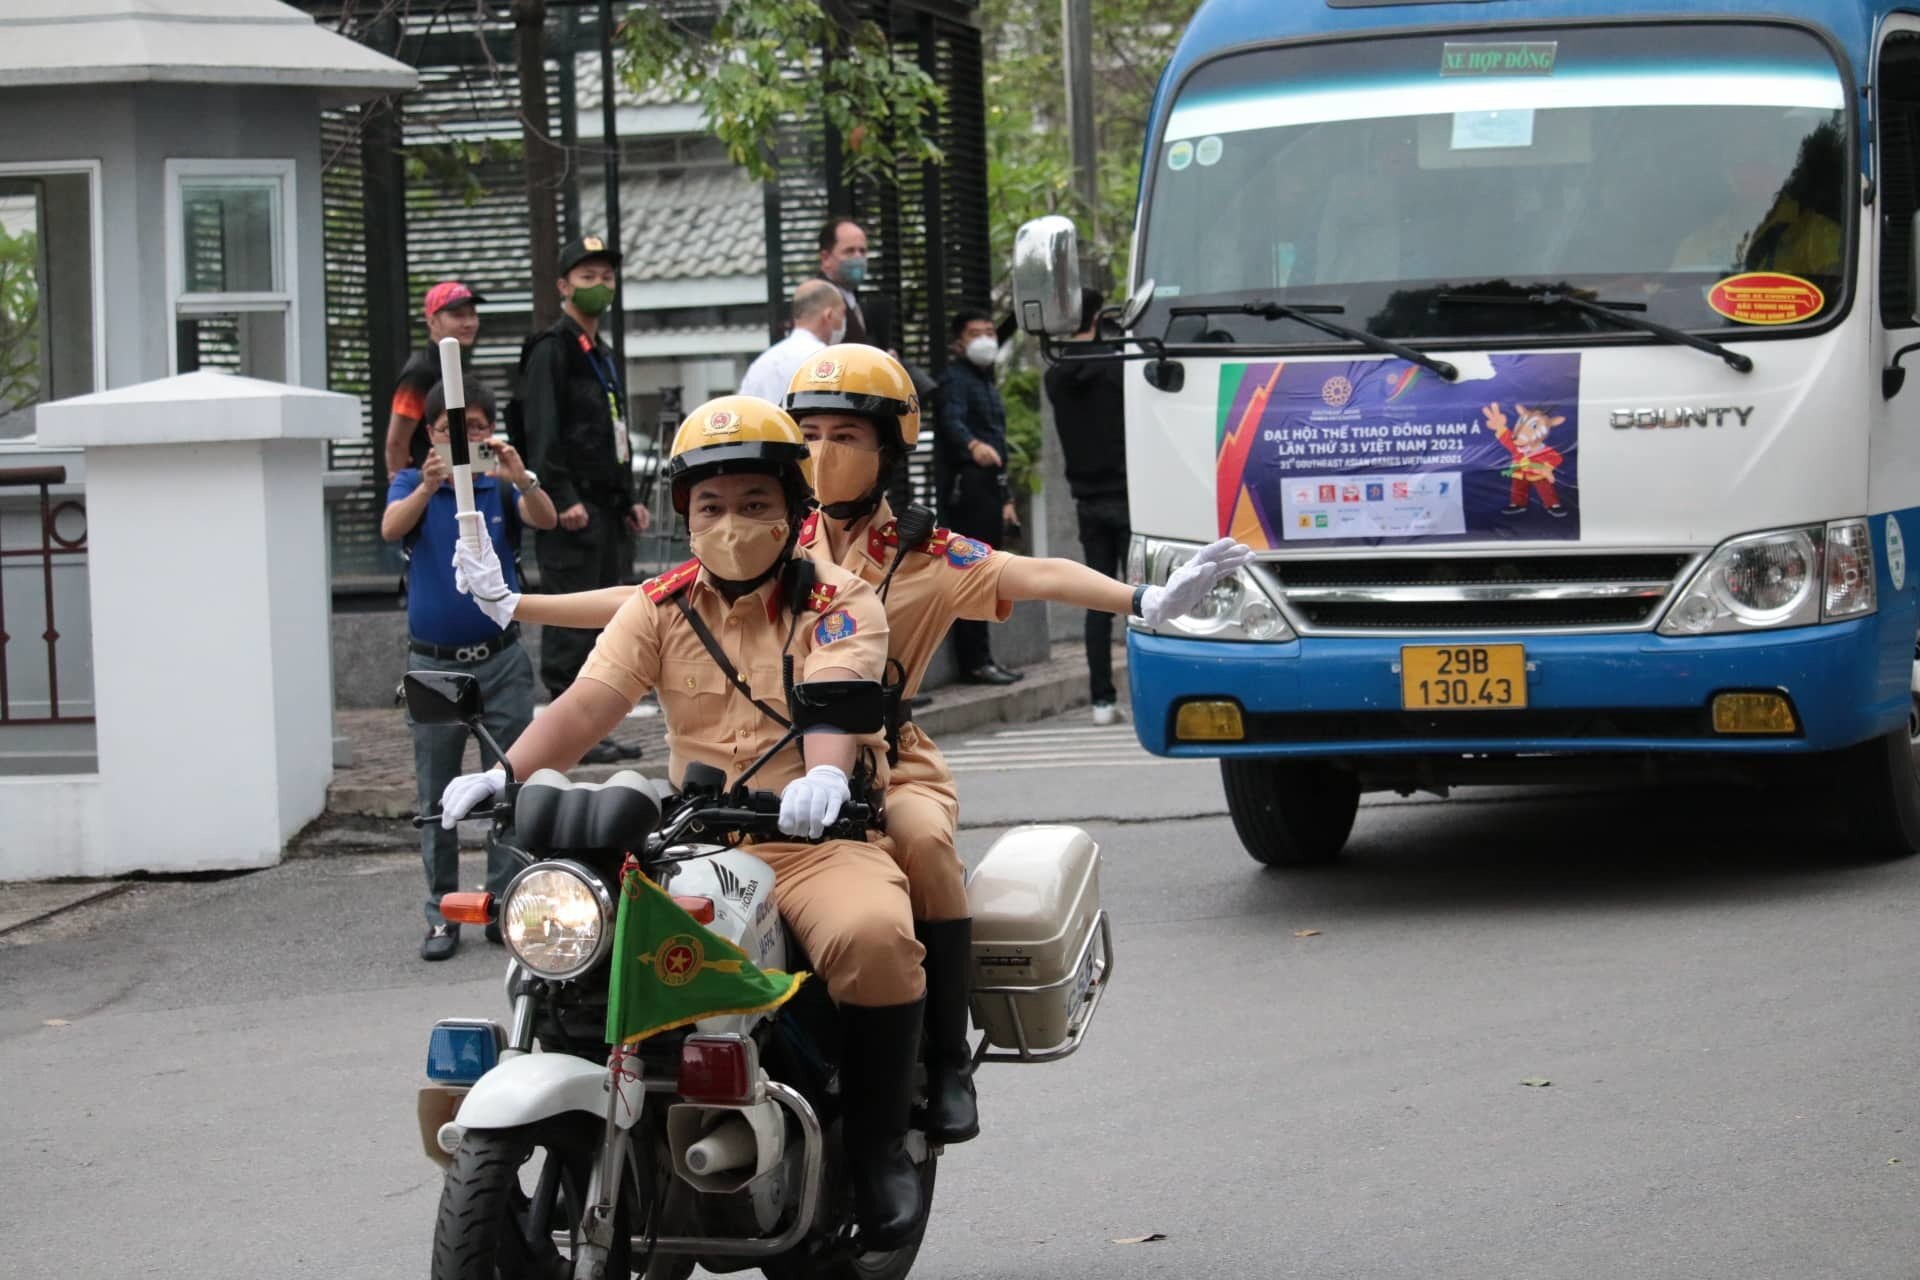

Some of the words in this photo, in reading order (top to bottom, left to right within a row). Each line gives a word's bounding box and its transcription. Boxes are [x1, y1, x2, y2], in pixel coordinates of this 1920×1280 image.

[1610, 405, 1755, 430] COUNTY
[1263, 429, 1289, 443] ĐẠI
[1292, 426, 1318, 442] HỘI
[1351, 425, 1389, 439] THAO
[1392, 421, 1433, 437] ĐÔNG
[1435, 423, 1467, 436] NAM
[1470, 419, 1481, 435] Á
[1308, 440, 1338, 454] THỨ
[1339, 442, 1357, 454] 31
[1360, 439, 1392, 455] VIỆT
[1396, 440, 1427, 452] NAM
[1430, 439, 1465, 451] 2021
[1436, 648, 1489, 675] 29B
[1419, 678, 1512, 705] 130.43
[739, 879, 759, 914] HONDA
